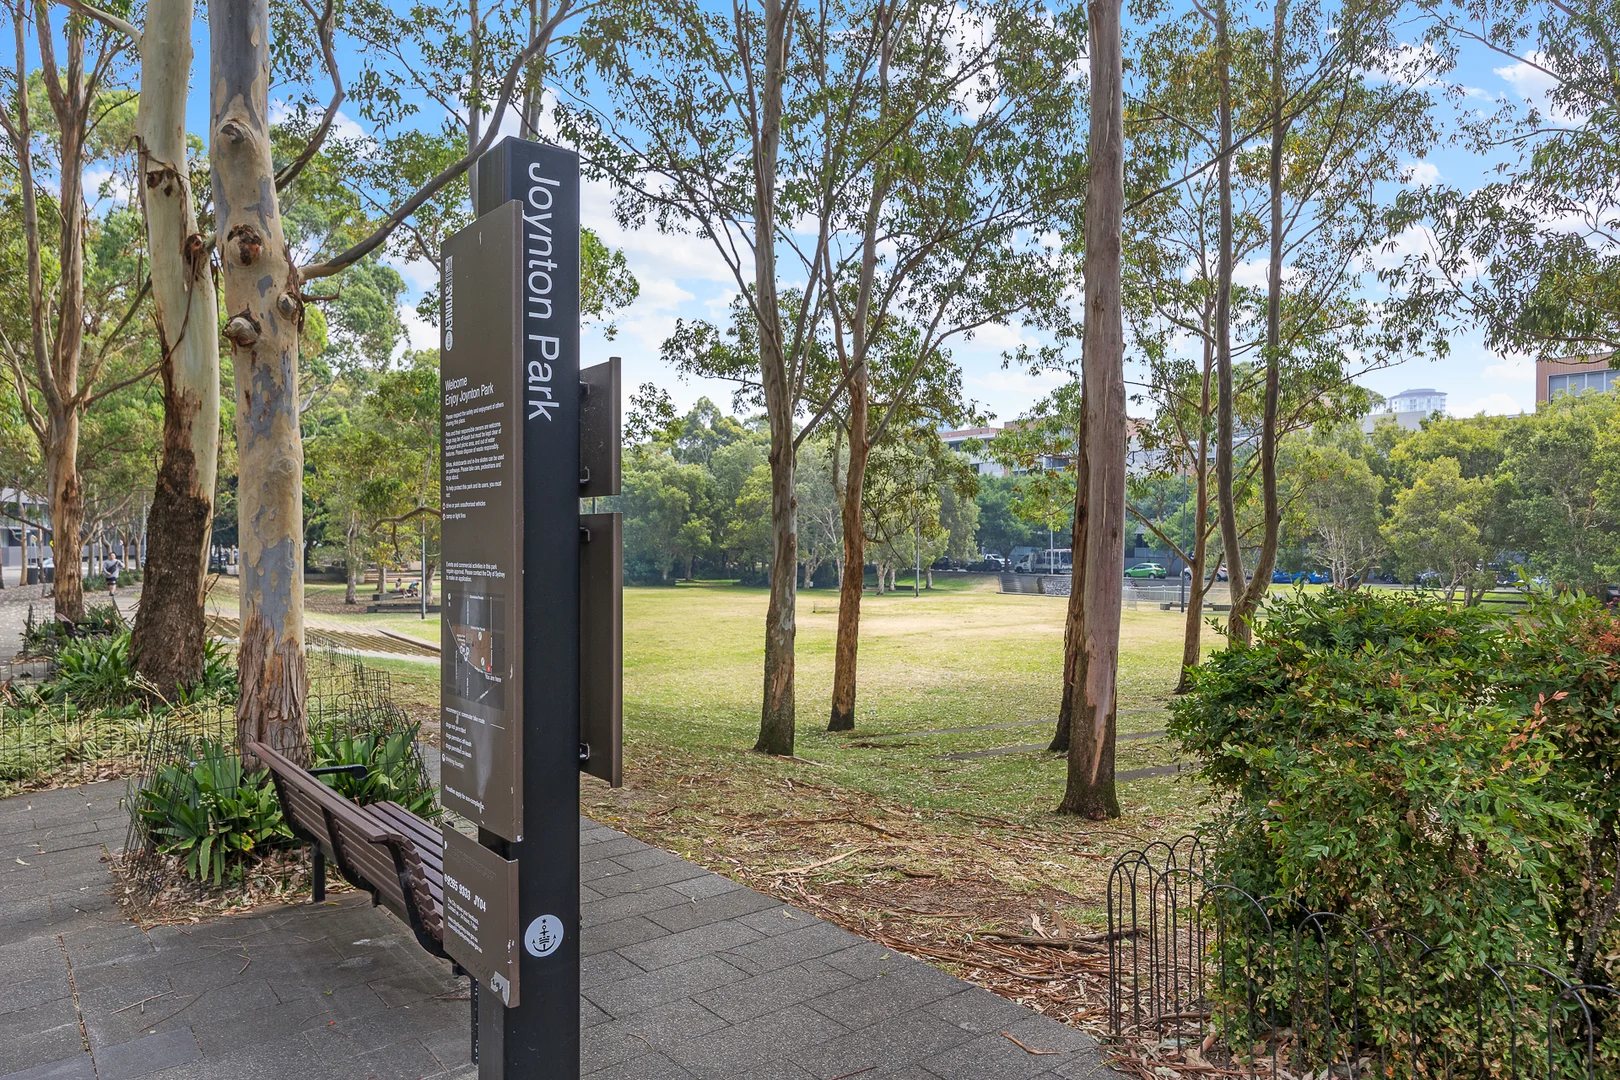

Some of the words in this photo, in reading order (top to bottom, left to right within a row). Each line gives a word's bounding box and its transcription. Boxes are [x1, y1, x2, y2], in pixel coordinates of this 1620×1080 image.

[523, 162, 560, 320] Joynton
[445, 377, 467, 391] Welcome
[528, 334, 560, 421] Park
[445, 393, 459, 407] Enjoy
[460, 388, 480, 403] Joynton
[481, 382, 494, 396] Park
[447, 876, 458, 890] 9265
[459, 884, 470, 900] 9333
